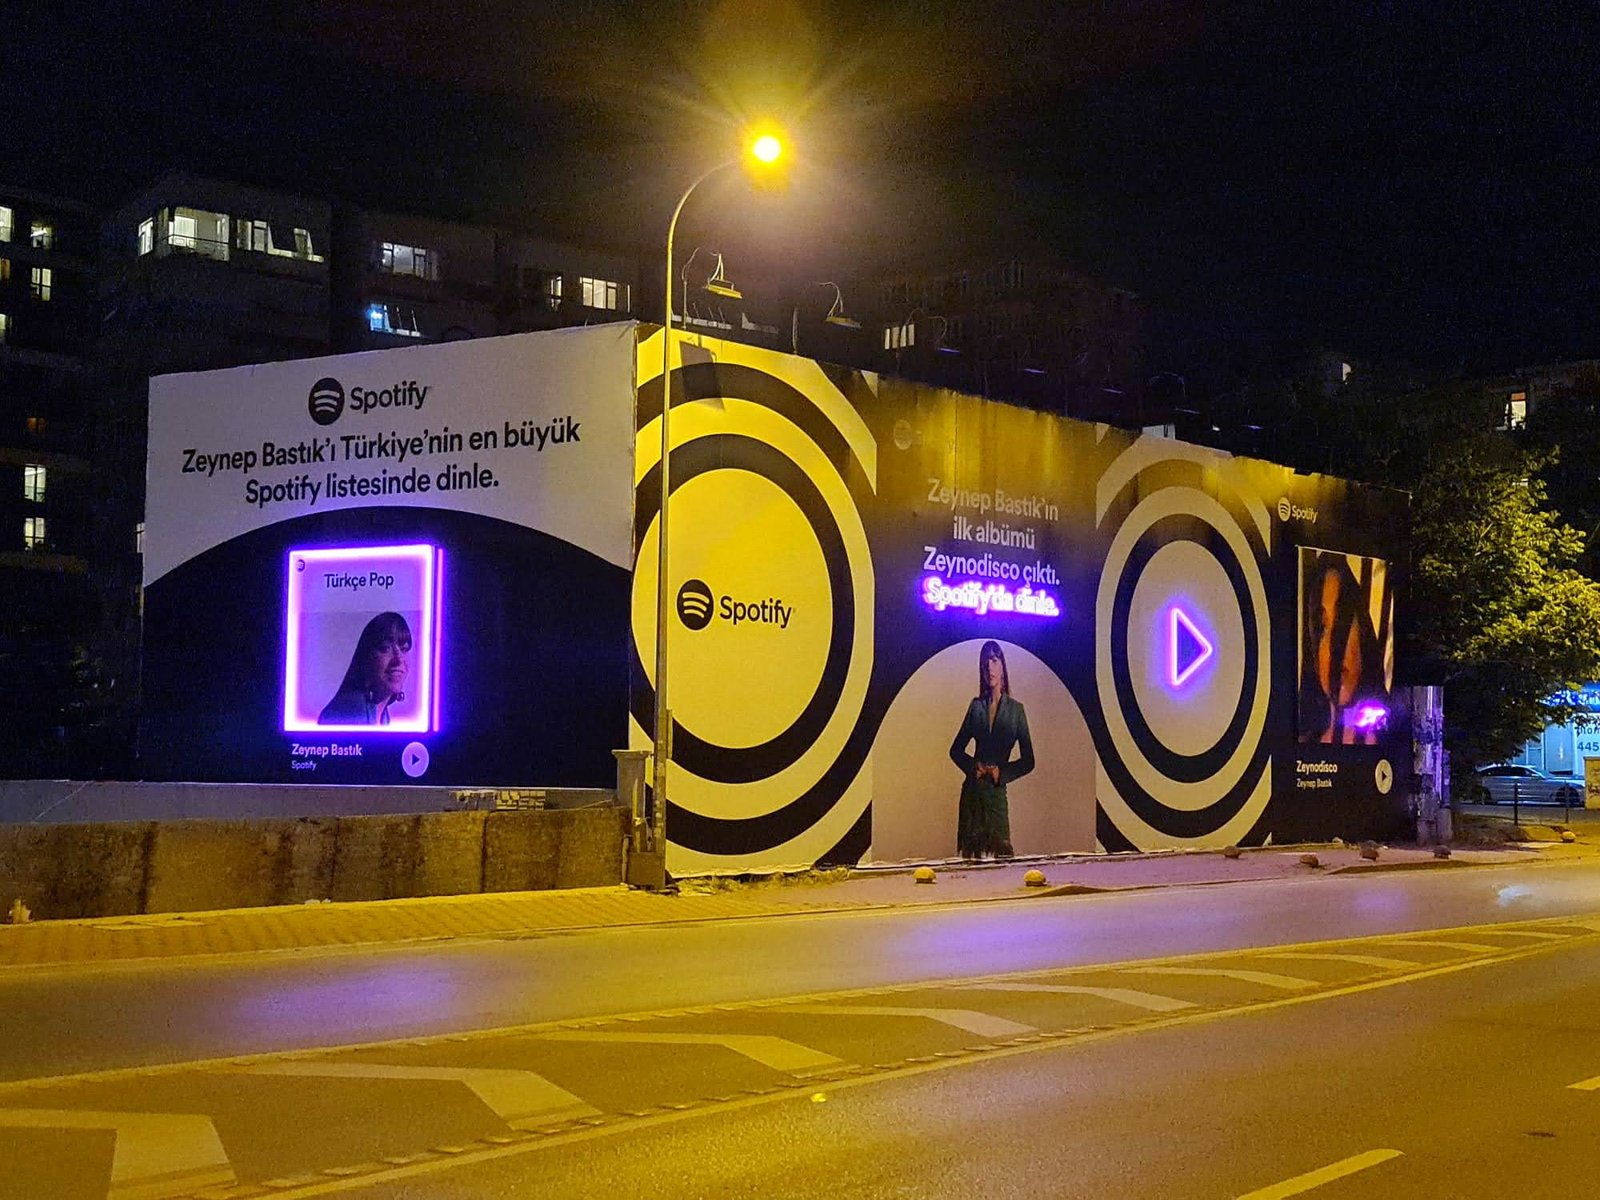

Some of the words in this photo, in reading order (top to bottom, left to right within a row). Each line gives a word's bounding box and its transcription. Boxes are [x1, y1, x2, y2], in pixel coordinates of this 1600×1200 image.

[349, 381, 427, 413] Spotify
[182, 449, 257, 477] Zeynep
[469, 431, 498, 450] en
[504, 415, 581, 448] büyük
[245, 473, 321, 508] Spotify
[326, 471, 430, 501] listesinde
[436, 463, 500, 491] dinle.
[927, 478, 991, 514] Zeynep
[1291, 505, 1318, 524] Spotify
[953, 515, 972, 541] ilk
[976, 520, 1035, 549] albümü
[324, 573, 366, 591] Türkçe
[369, 572, 394, 589] Pop
[923, 546, 1020, 581] Zeynodisco
[1023, 561, 1060, 586] çıktı.
[719, 595, 792, 629] Spotify
[291, 743, 329, 757] Zeynep
[331, 743, 363, 757] Bastık
[291, 760, 317, 771] Spotify
[1296, 760, 1338, 775] Zeynodisco
